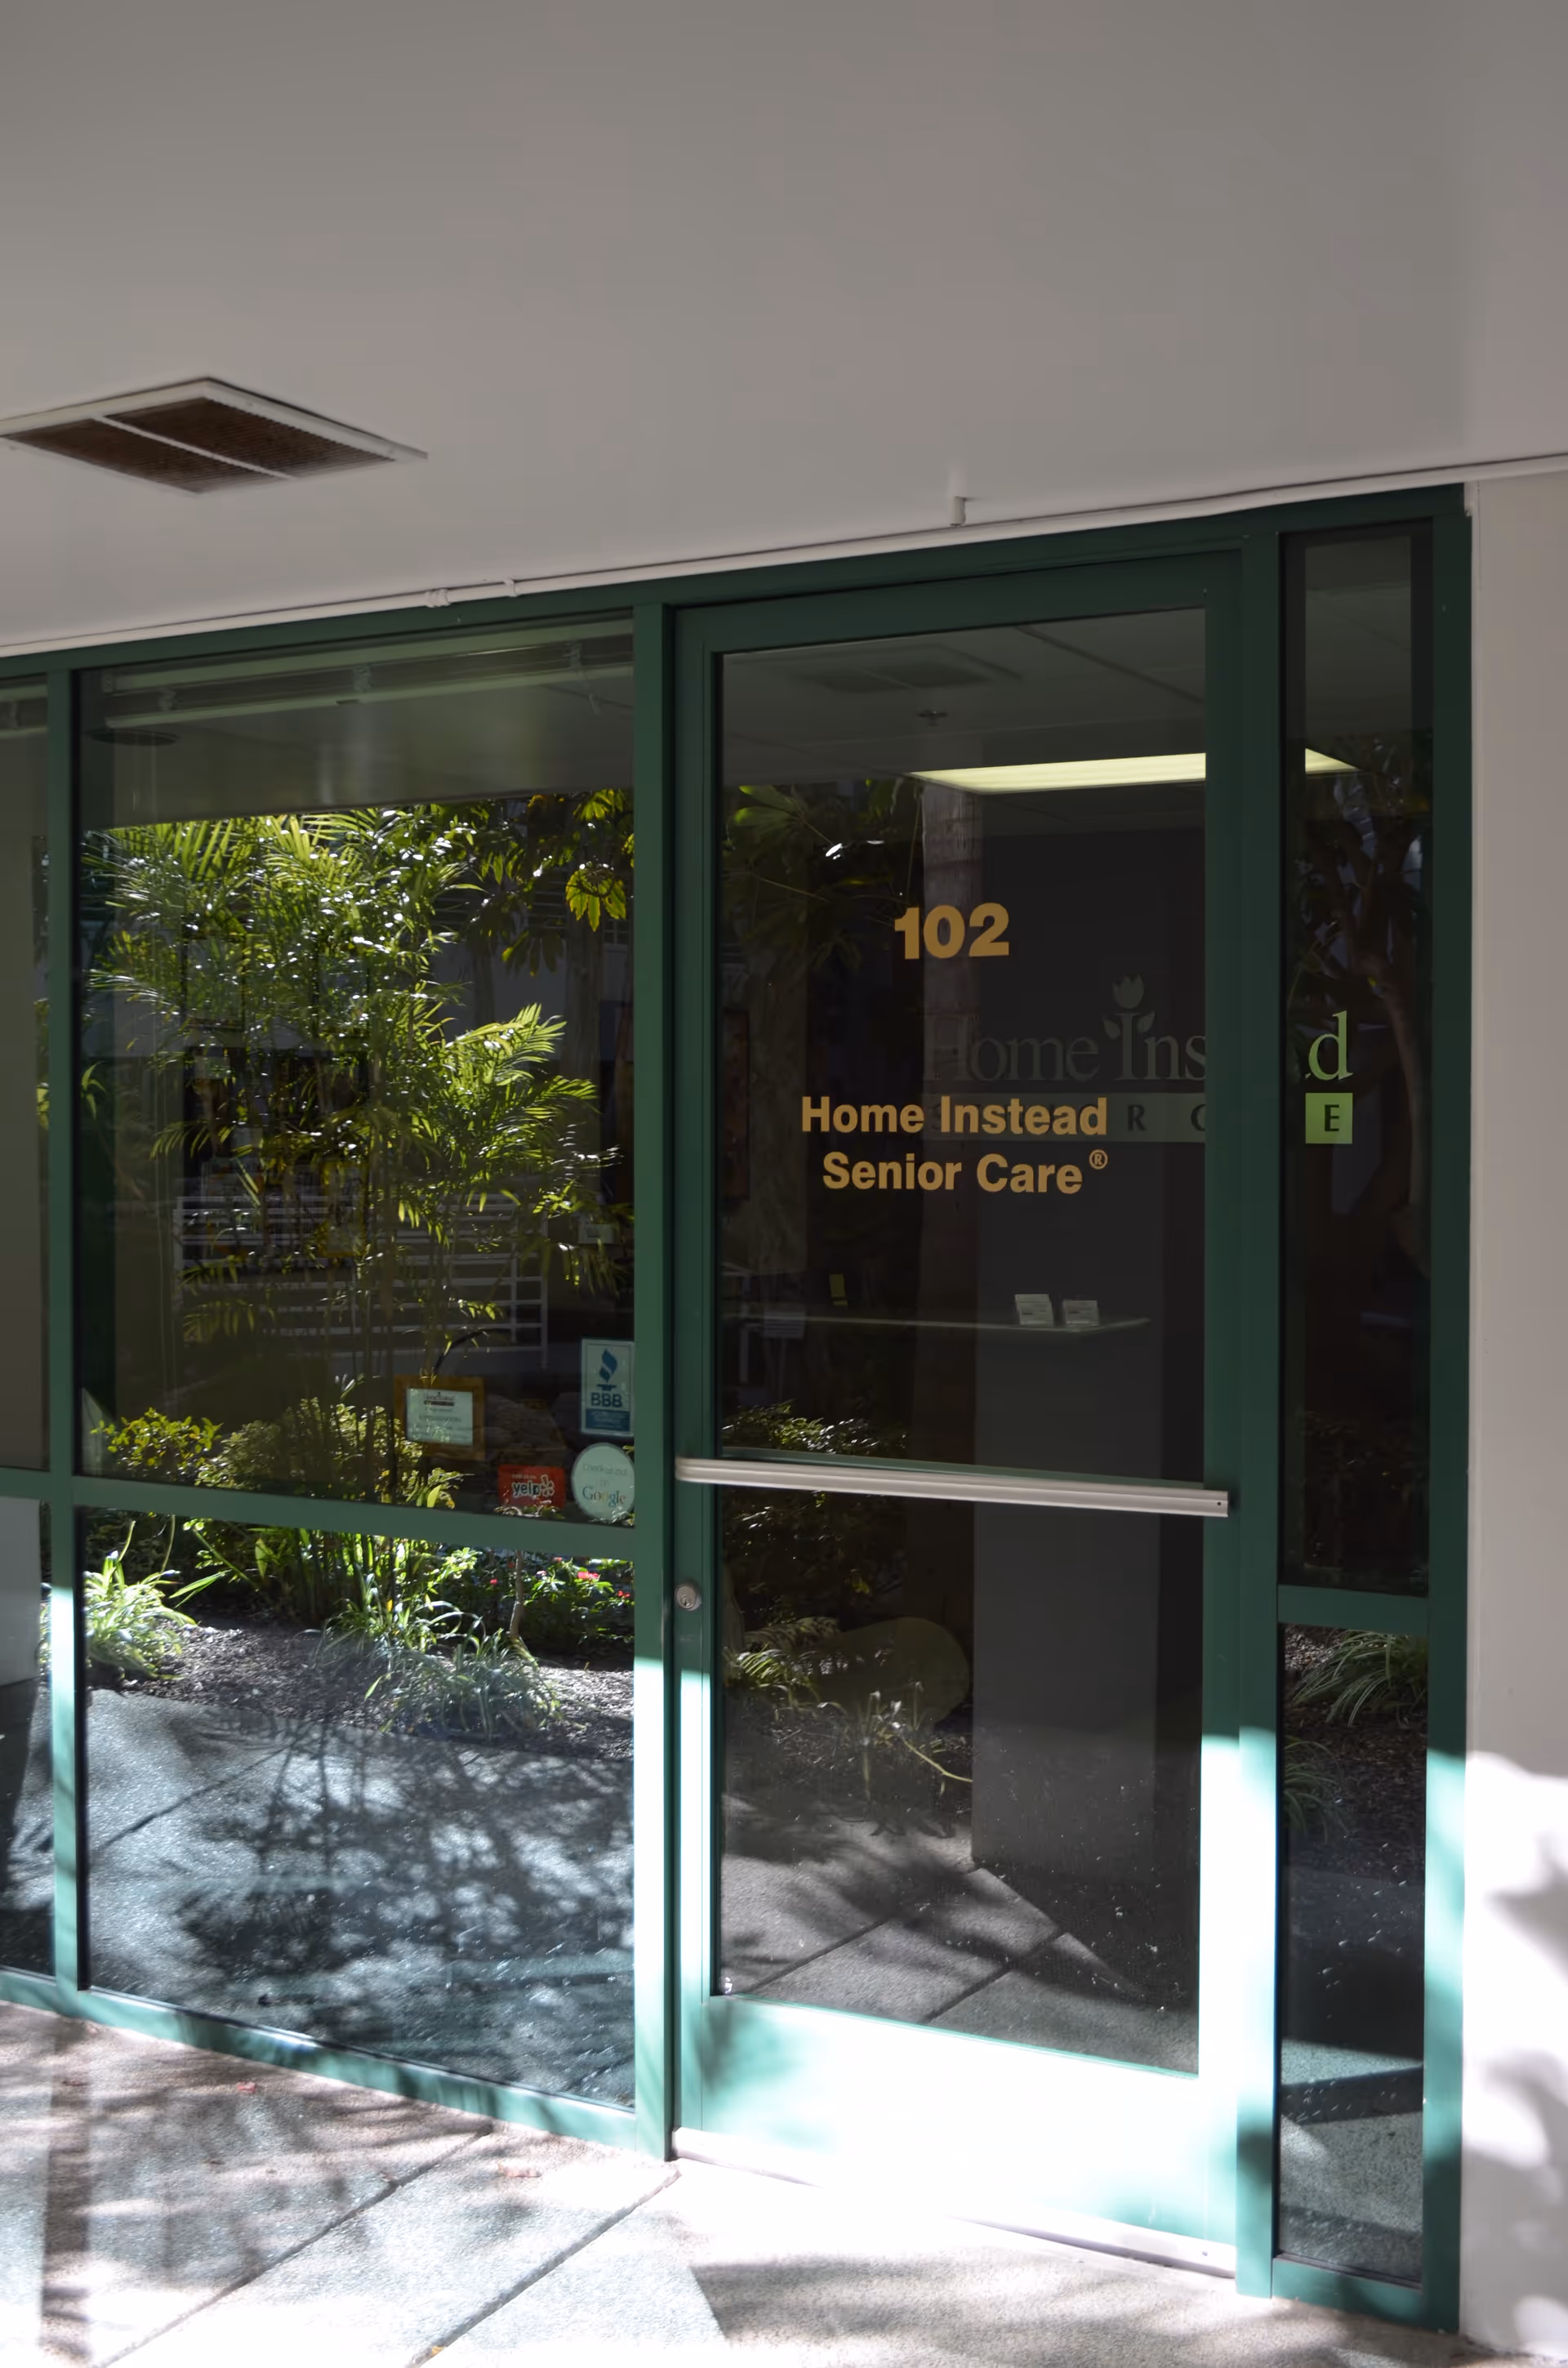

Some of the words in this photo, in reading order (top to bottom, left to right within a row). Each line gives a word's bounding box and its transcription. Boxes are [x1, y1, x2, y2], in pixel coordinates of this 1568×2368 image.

[893, 902, 1010, 960] 102
[801, 1096, 924, 1133] Home
[941, 1097, 1107, 1135] Instead
[822, 1152, 962, 1190] Senior
[590, 1393, 622, 1407] BBB
[512, 1480, 541, 1498] yelp
[582, 1486, 626, 1508] Google
